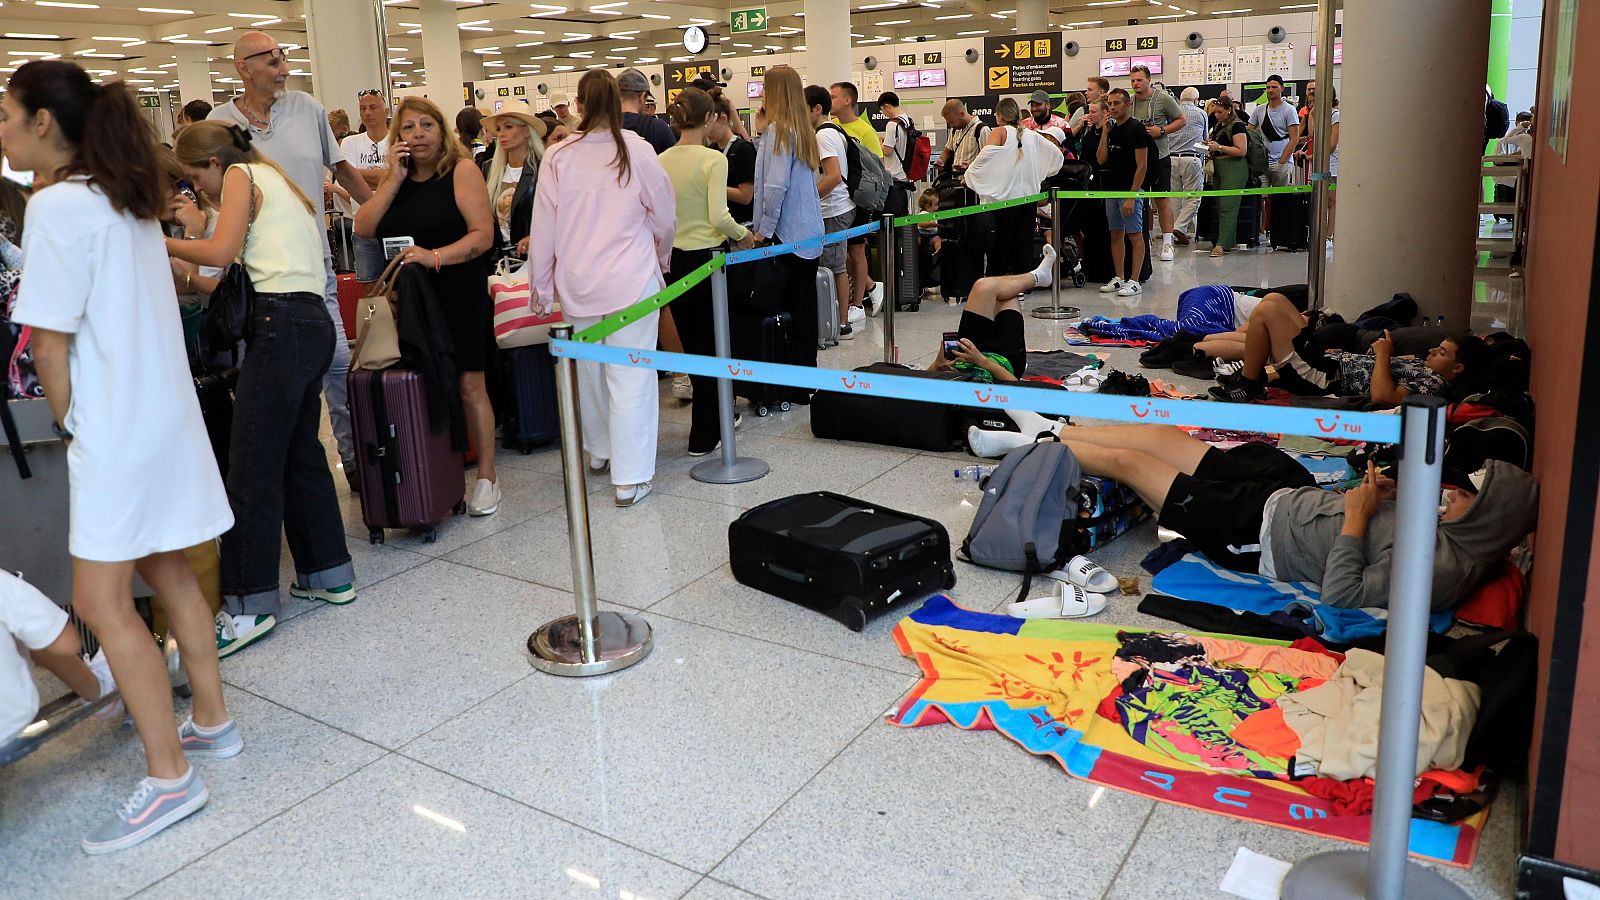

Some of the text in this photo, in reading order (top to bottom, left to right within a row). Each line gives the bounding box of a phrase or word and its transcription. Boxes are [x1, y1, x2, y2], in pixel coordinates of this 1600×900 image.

[1110, 40, 1123, 50] 48
[1140, 38, 1154, 48] 49
[901, 55, 913, 65] 46
[927, 53, 939, 63] 47
[753, 67, 764, 75] 44
[972, 108, 992, 116] aena
[995, 394, 1008, 403] TUI
[1154, 408, 1170, 418] TUI
[1343, 423, 1362, 433] TUI
